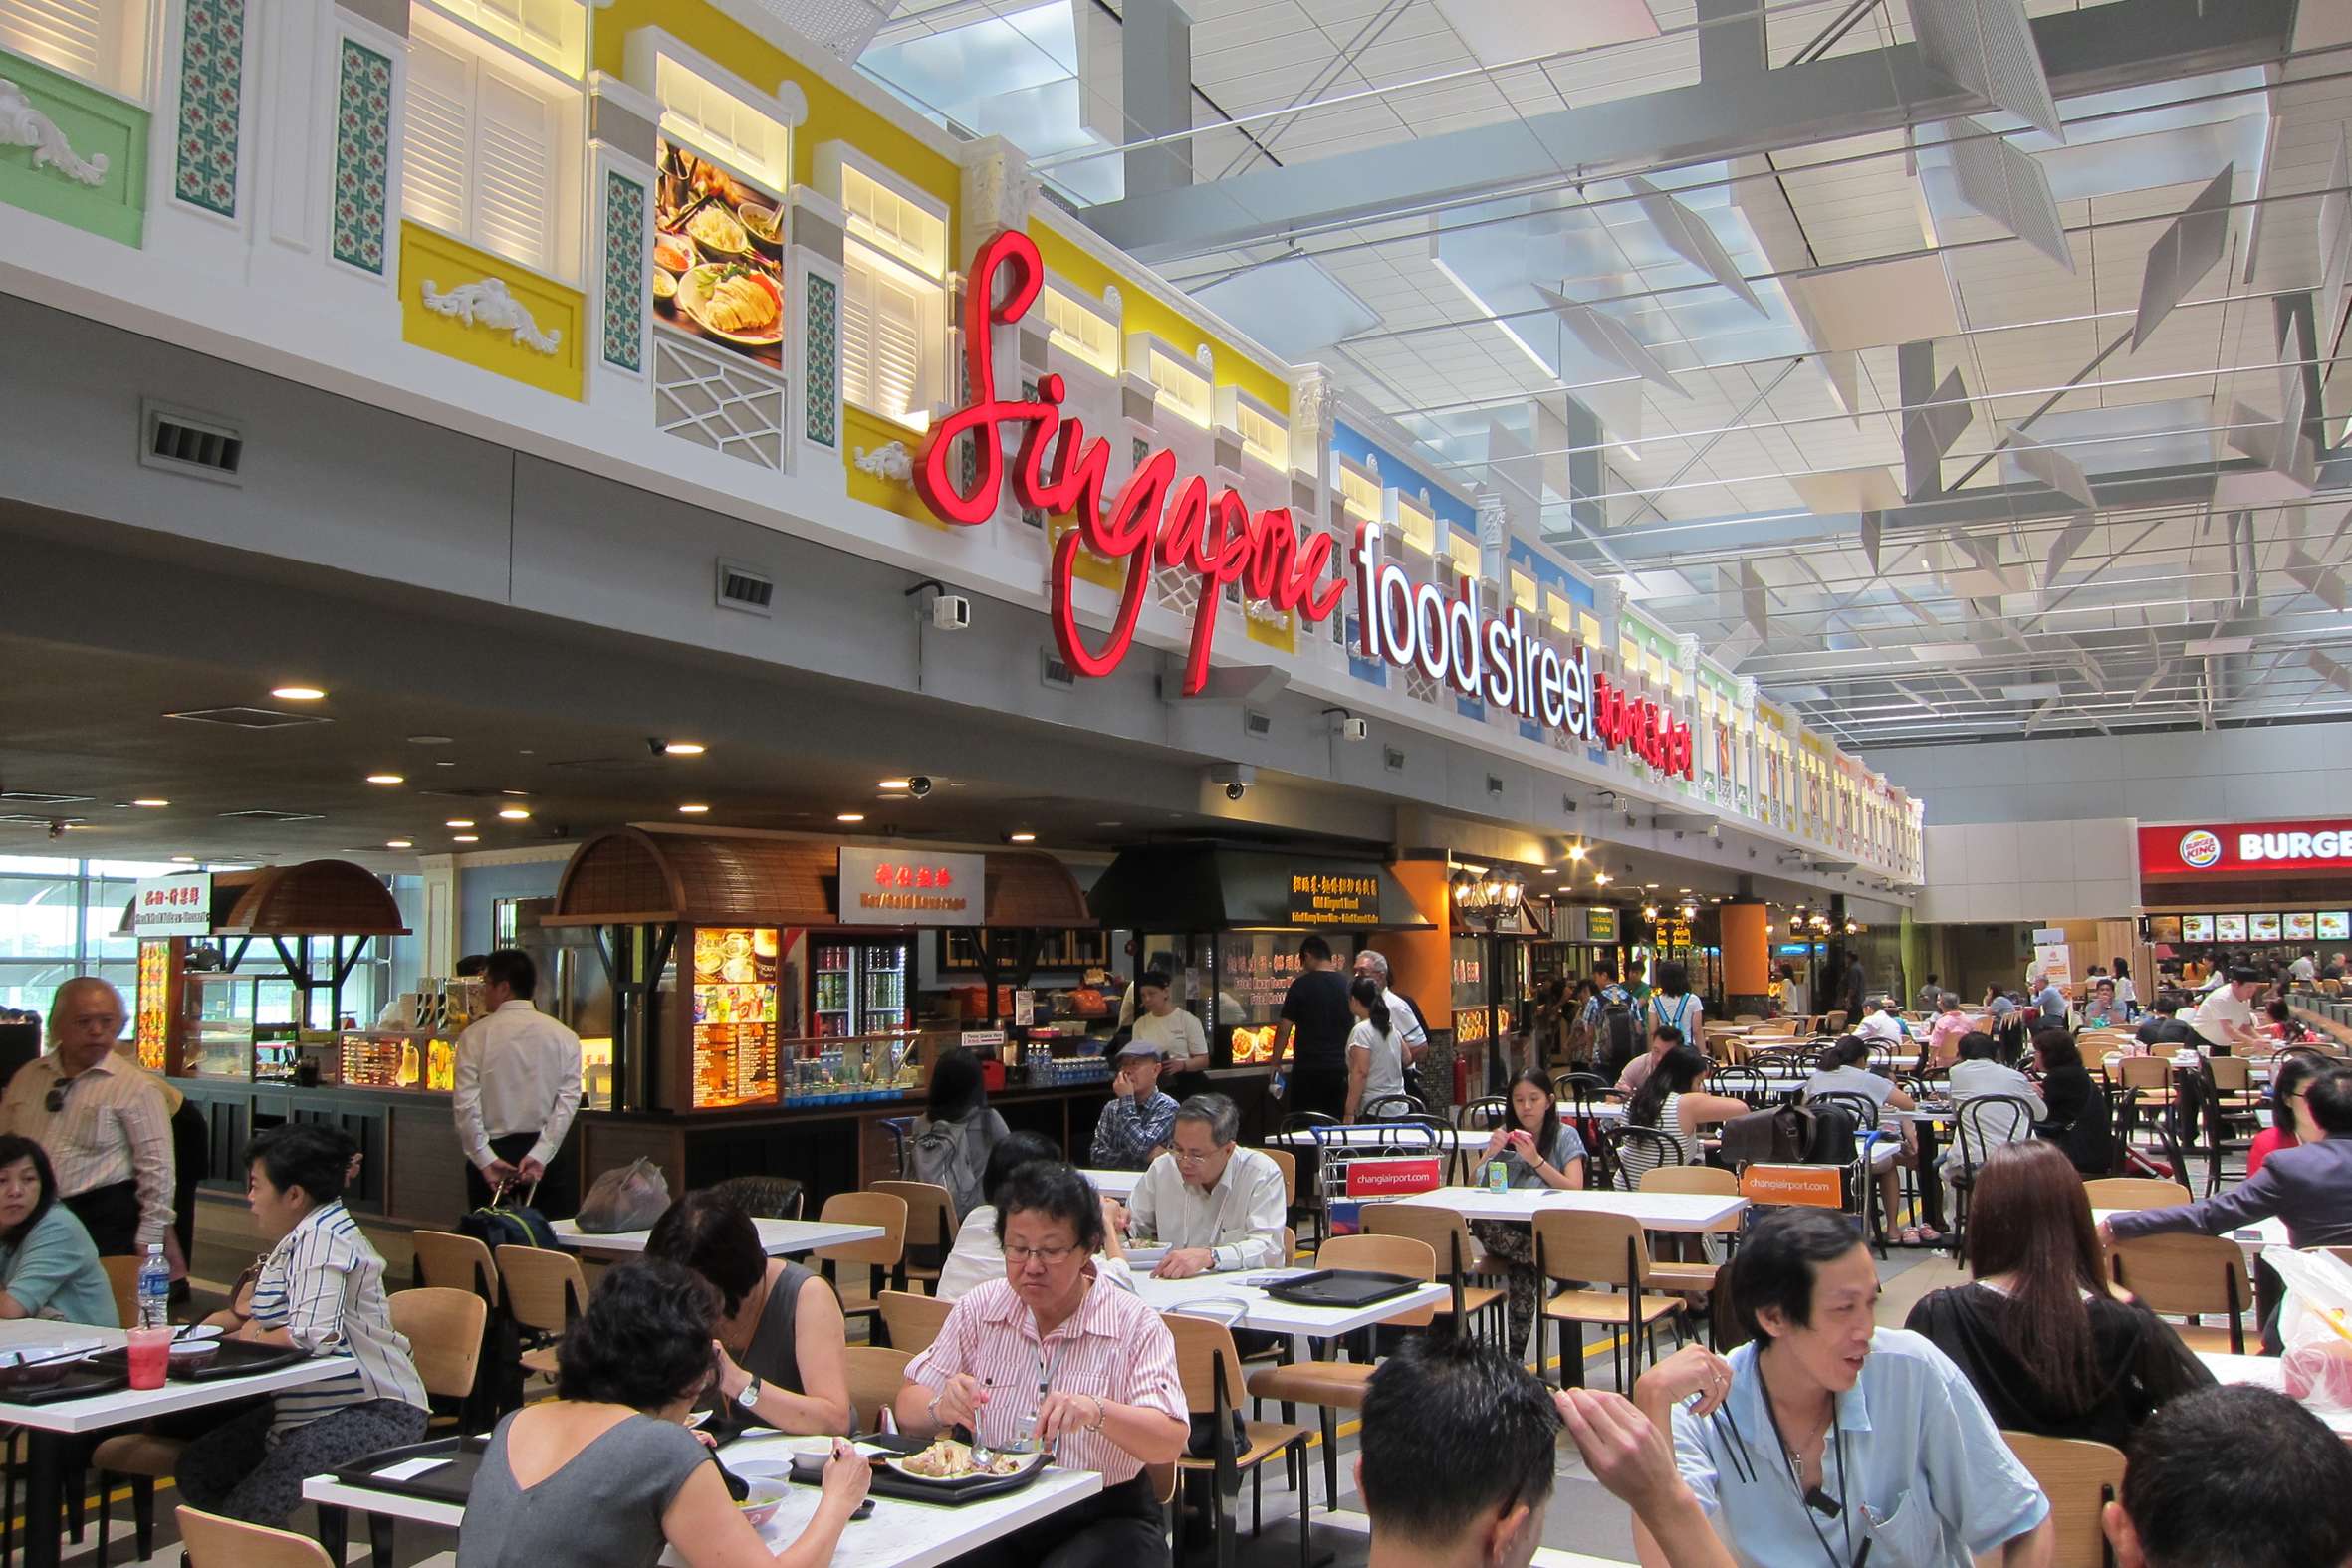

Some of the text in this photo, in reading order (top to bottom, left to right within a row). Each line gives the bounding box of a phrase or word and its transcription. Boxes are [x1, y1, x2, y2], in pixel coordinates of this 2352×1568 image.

[913, 229, 1593, 741] Singapore food street
[2185, 837, 2215, 850] BURGER
[2186, 845, 2216, 860] KING
[1357, 1173, 1430, 1185] changiairport.com
[1749, 1178, 1830, 1192] changiairport.com
